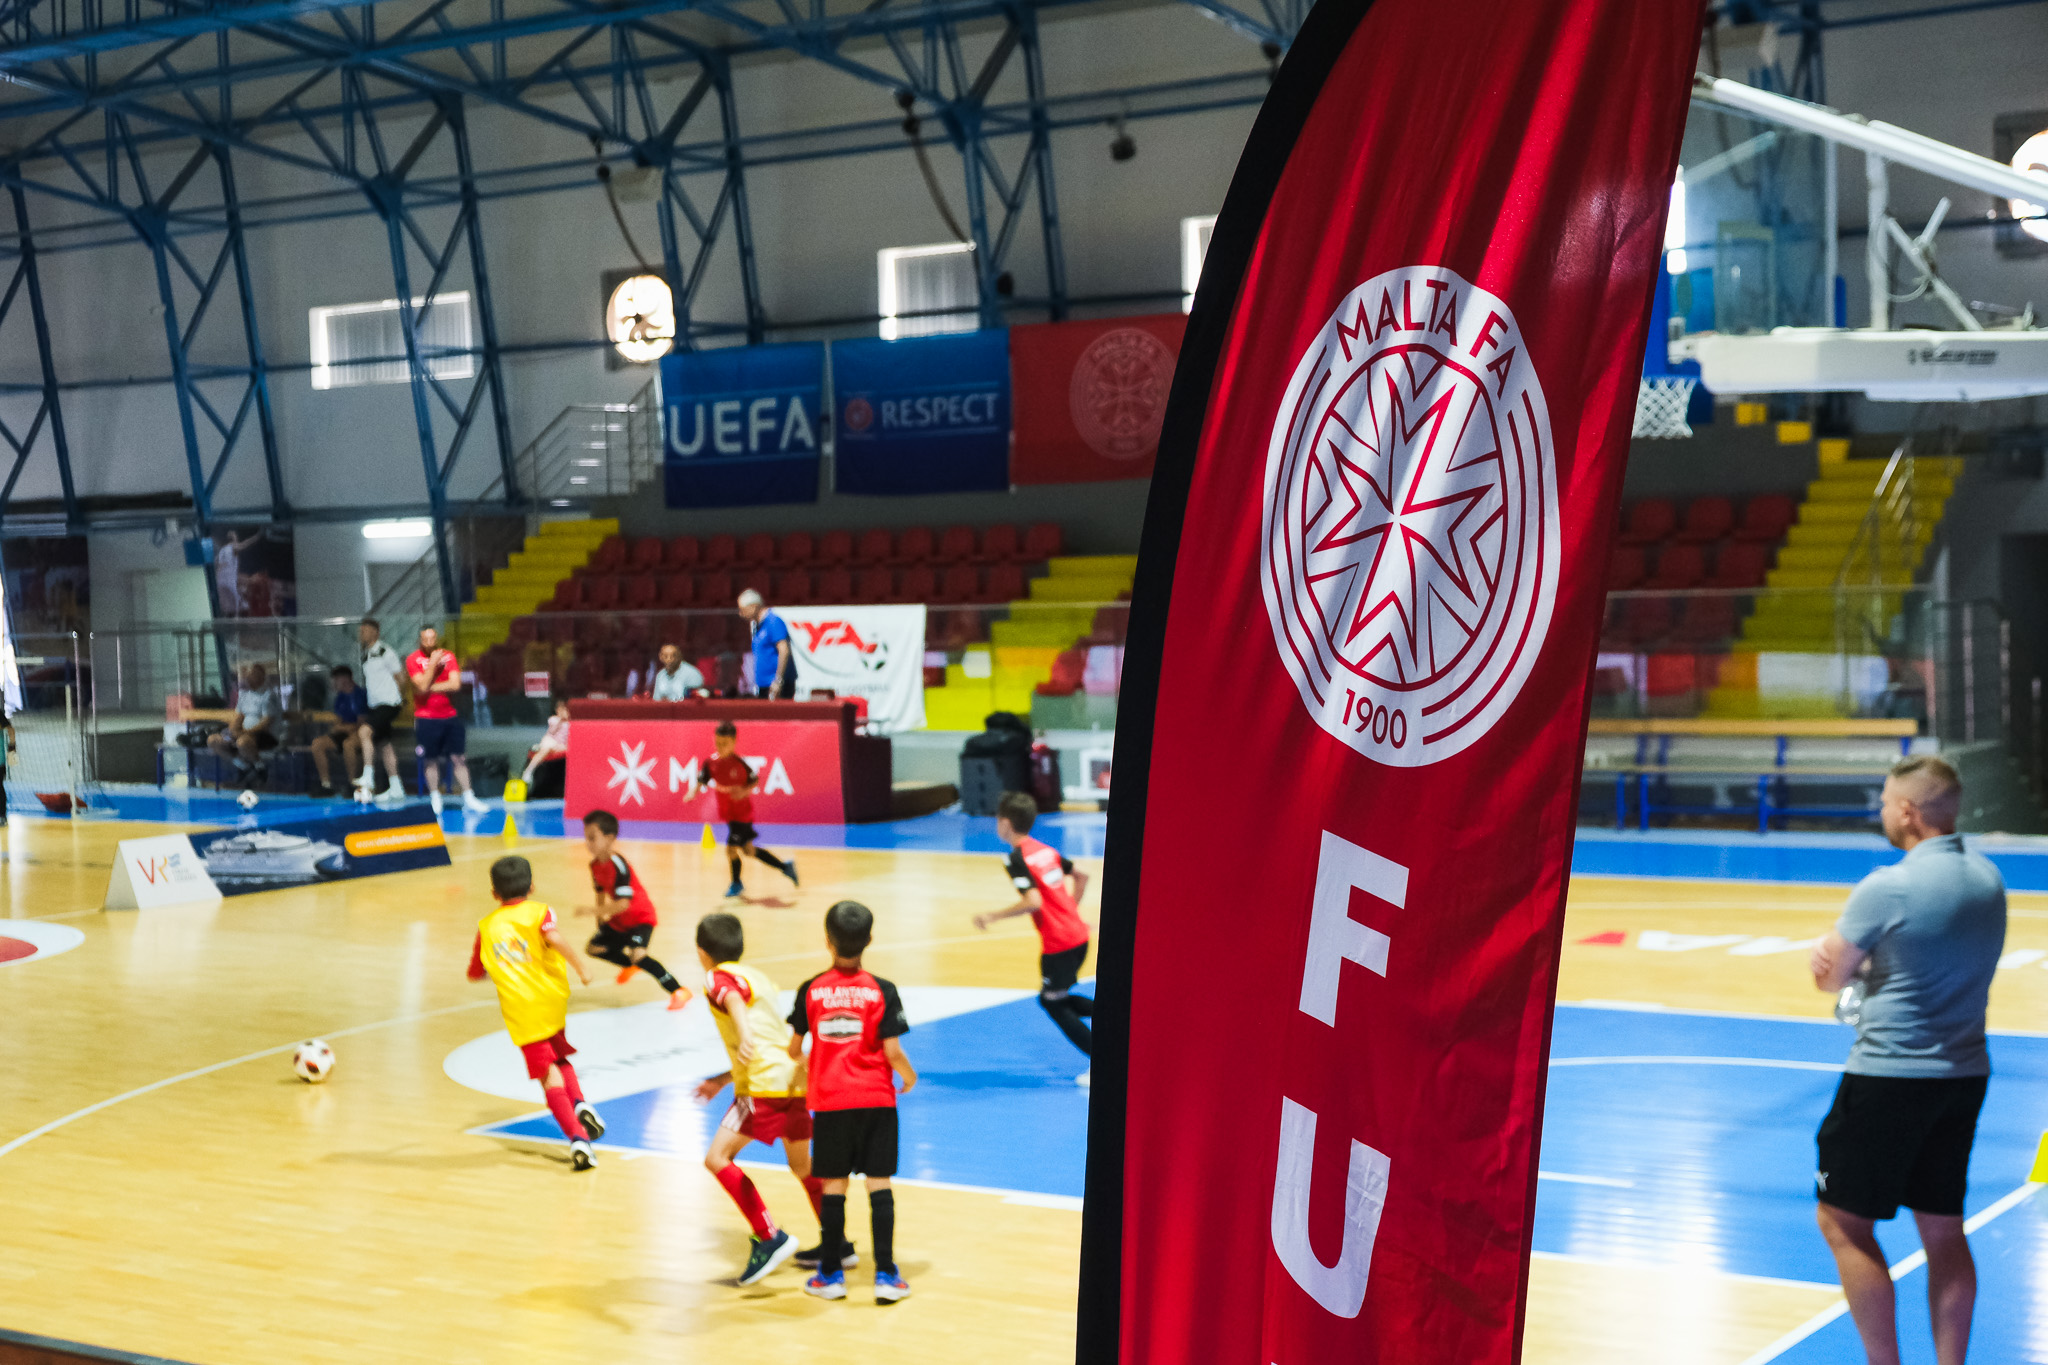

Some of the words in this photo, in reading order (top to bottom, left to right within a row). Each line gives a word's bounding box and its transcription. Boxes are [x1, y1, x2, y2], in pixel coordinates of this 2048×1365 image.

[1336, 279, 1458, 362] MALTA
[1469, 310, 1516, 400] FA
[669, 396, 815, 455] UEFA
[881, 393, 998, 429] RESPECT
[1342, 688, 1407, 749] 1900
[669, 756, 794, 795] MTA
[1270, 829, 1410, 1365] FU
